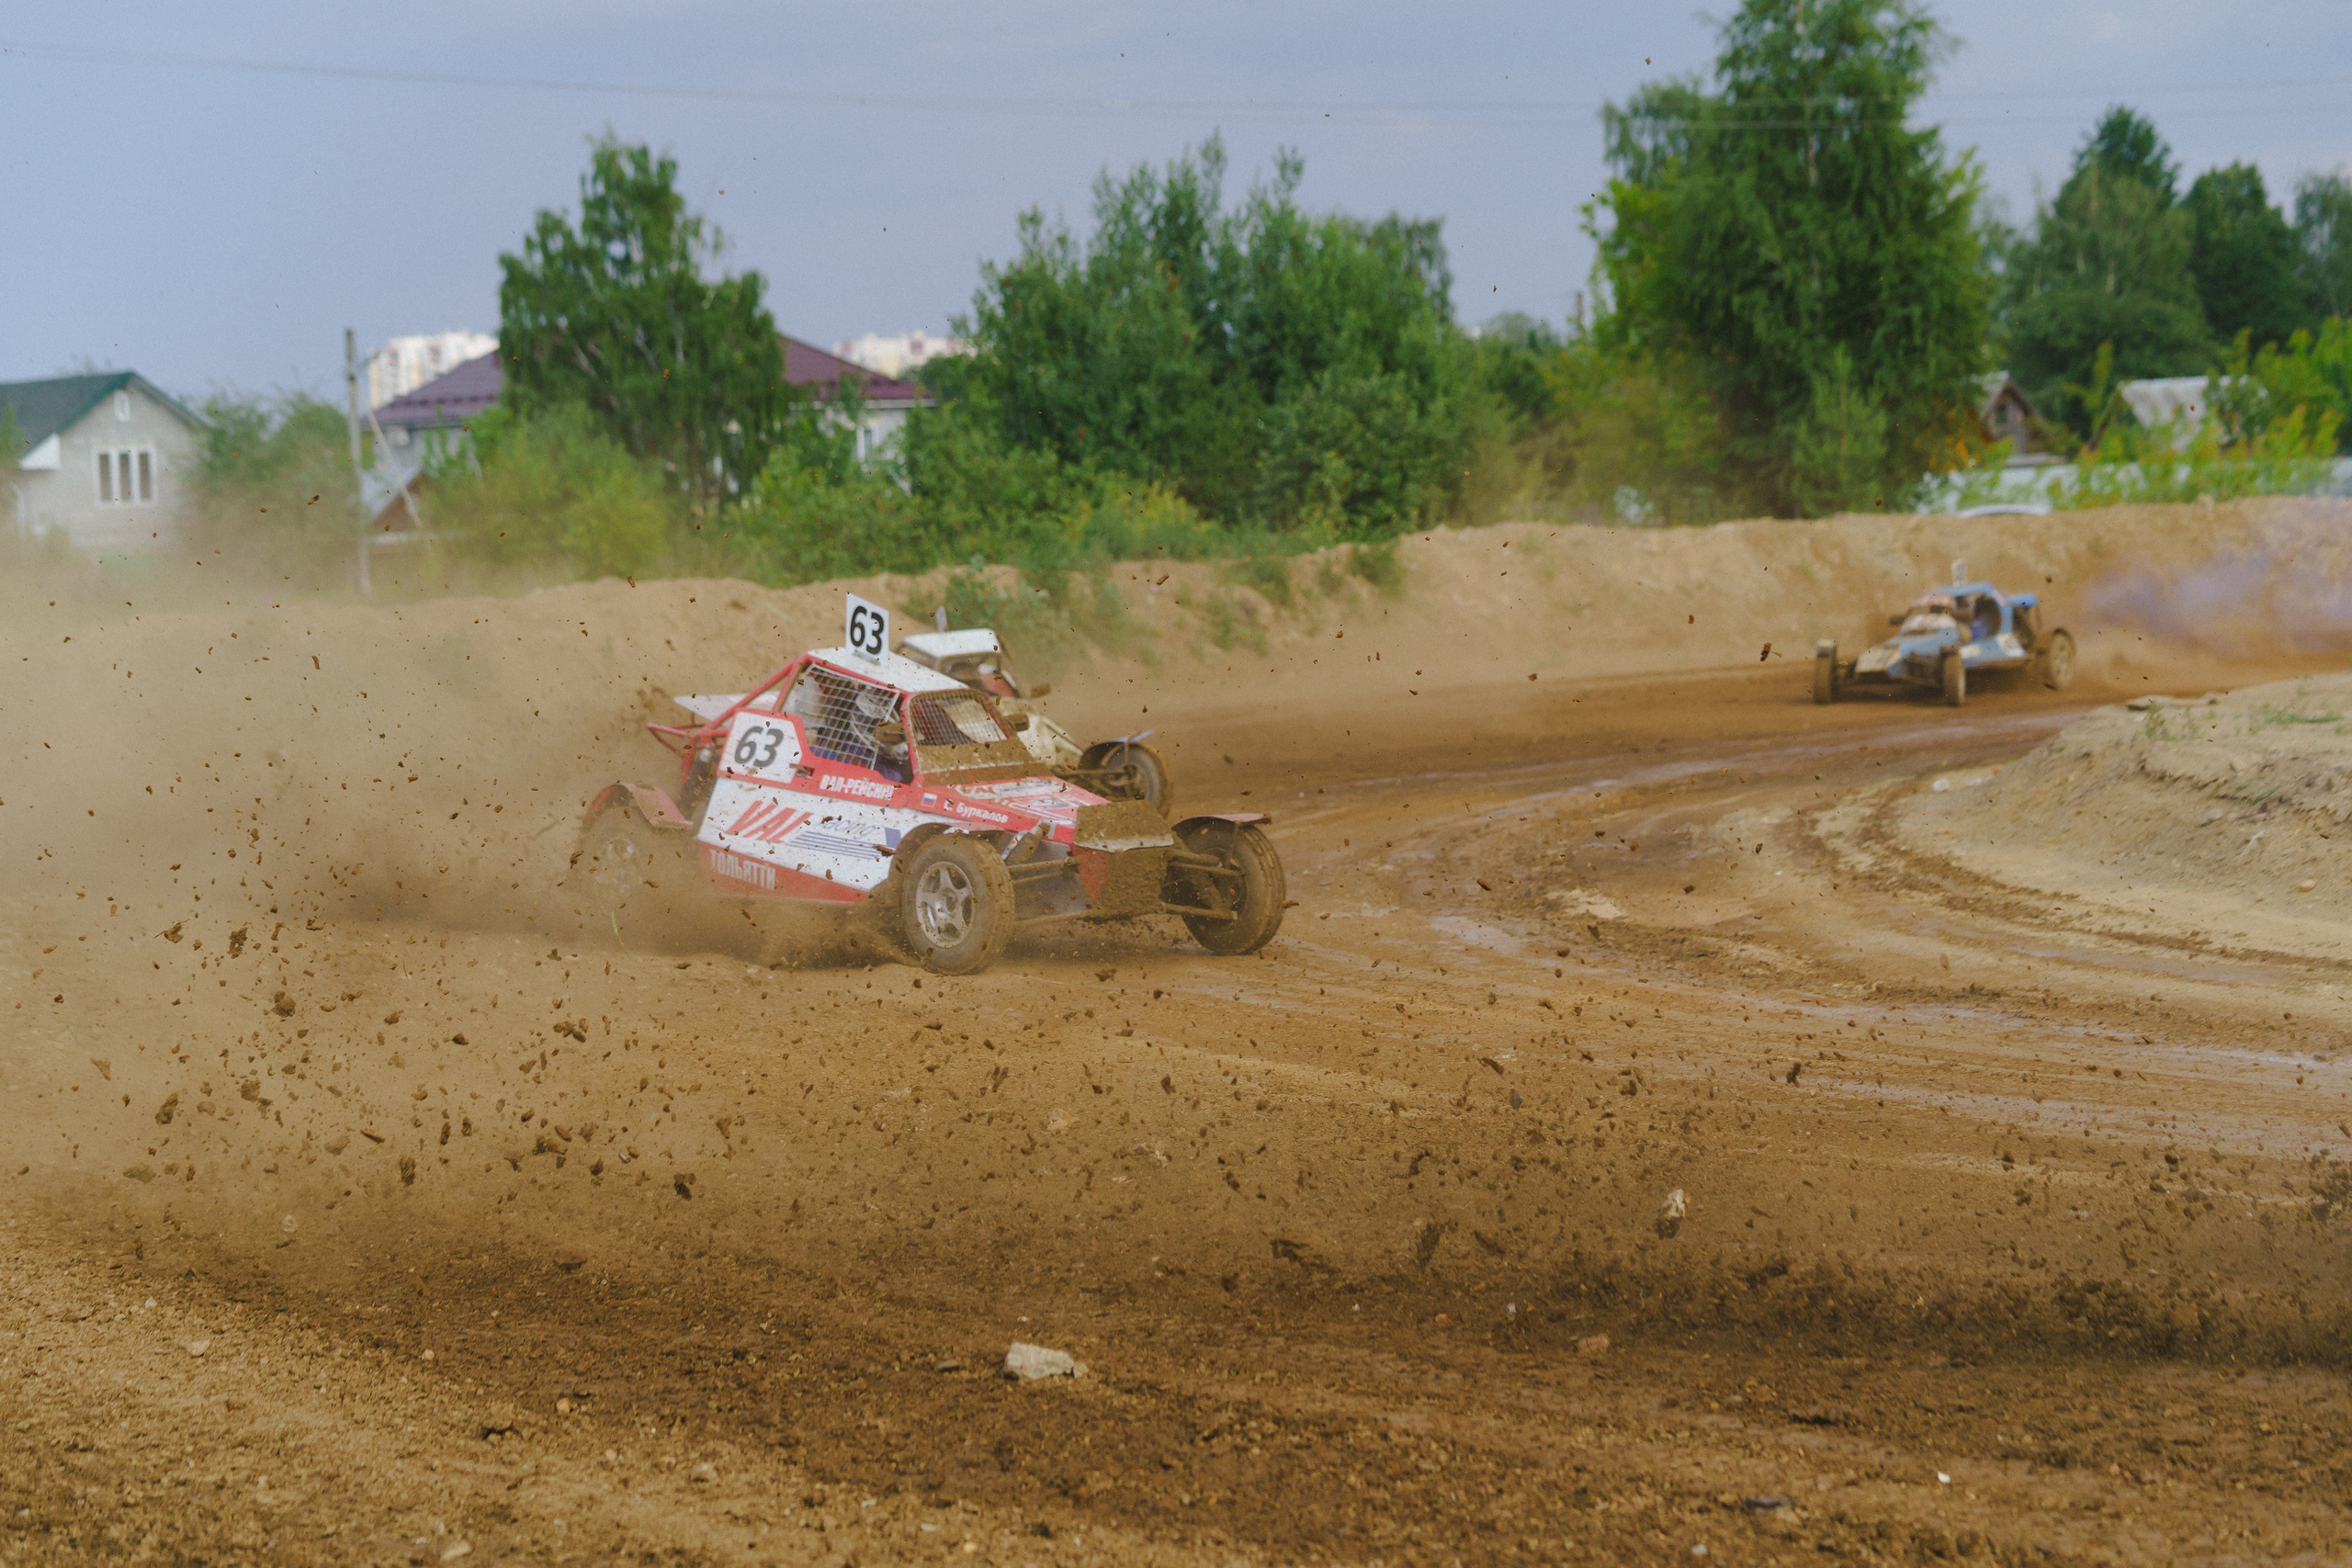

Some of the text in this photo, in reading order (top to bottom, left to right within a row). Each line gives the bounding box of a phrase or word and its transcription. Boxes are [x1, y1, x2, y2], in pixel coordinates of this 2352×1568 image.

[849, 605, 885, 655] 63
[734, 726, 785, 768] 63
[723, 800, 815, 844] VAL
[956, 802, 1009, 823] Буркалов
[709, 848, 775, 891] ТОЛЬЯТТИ
